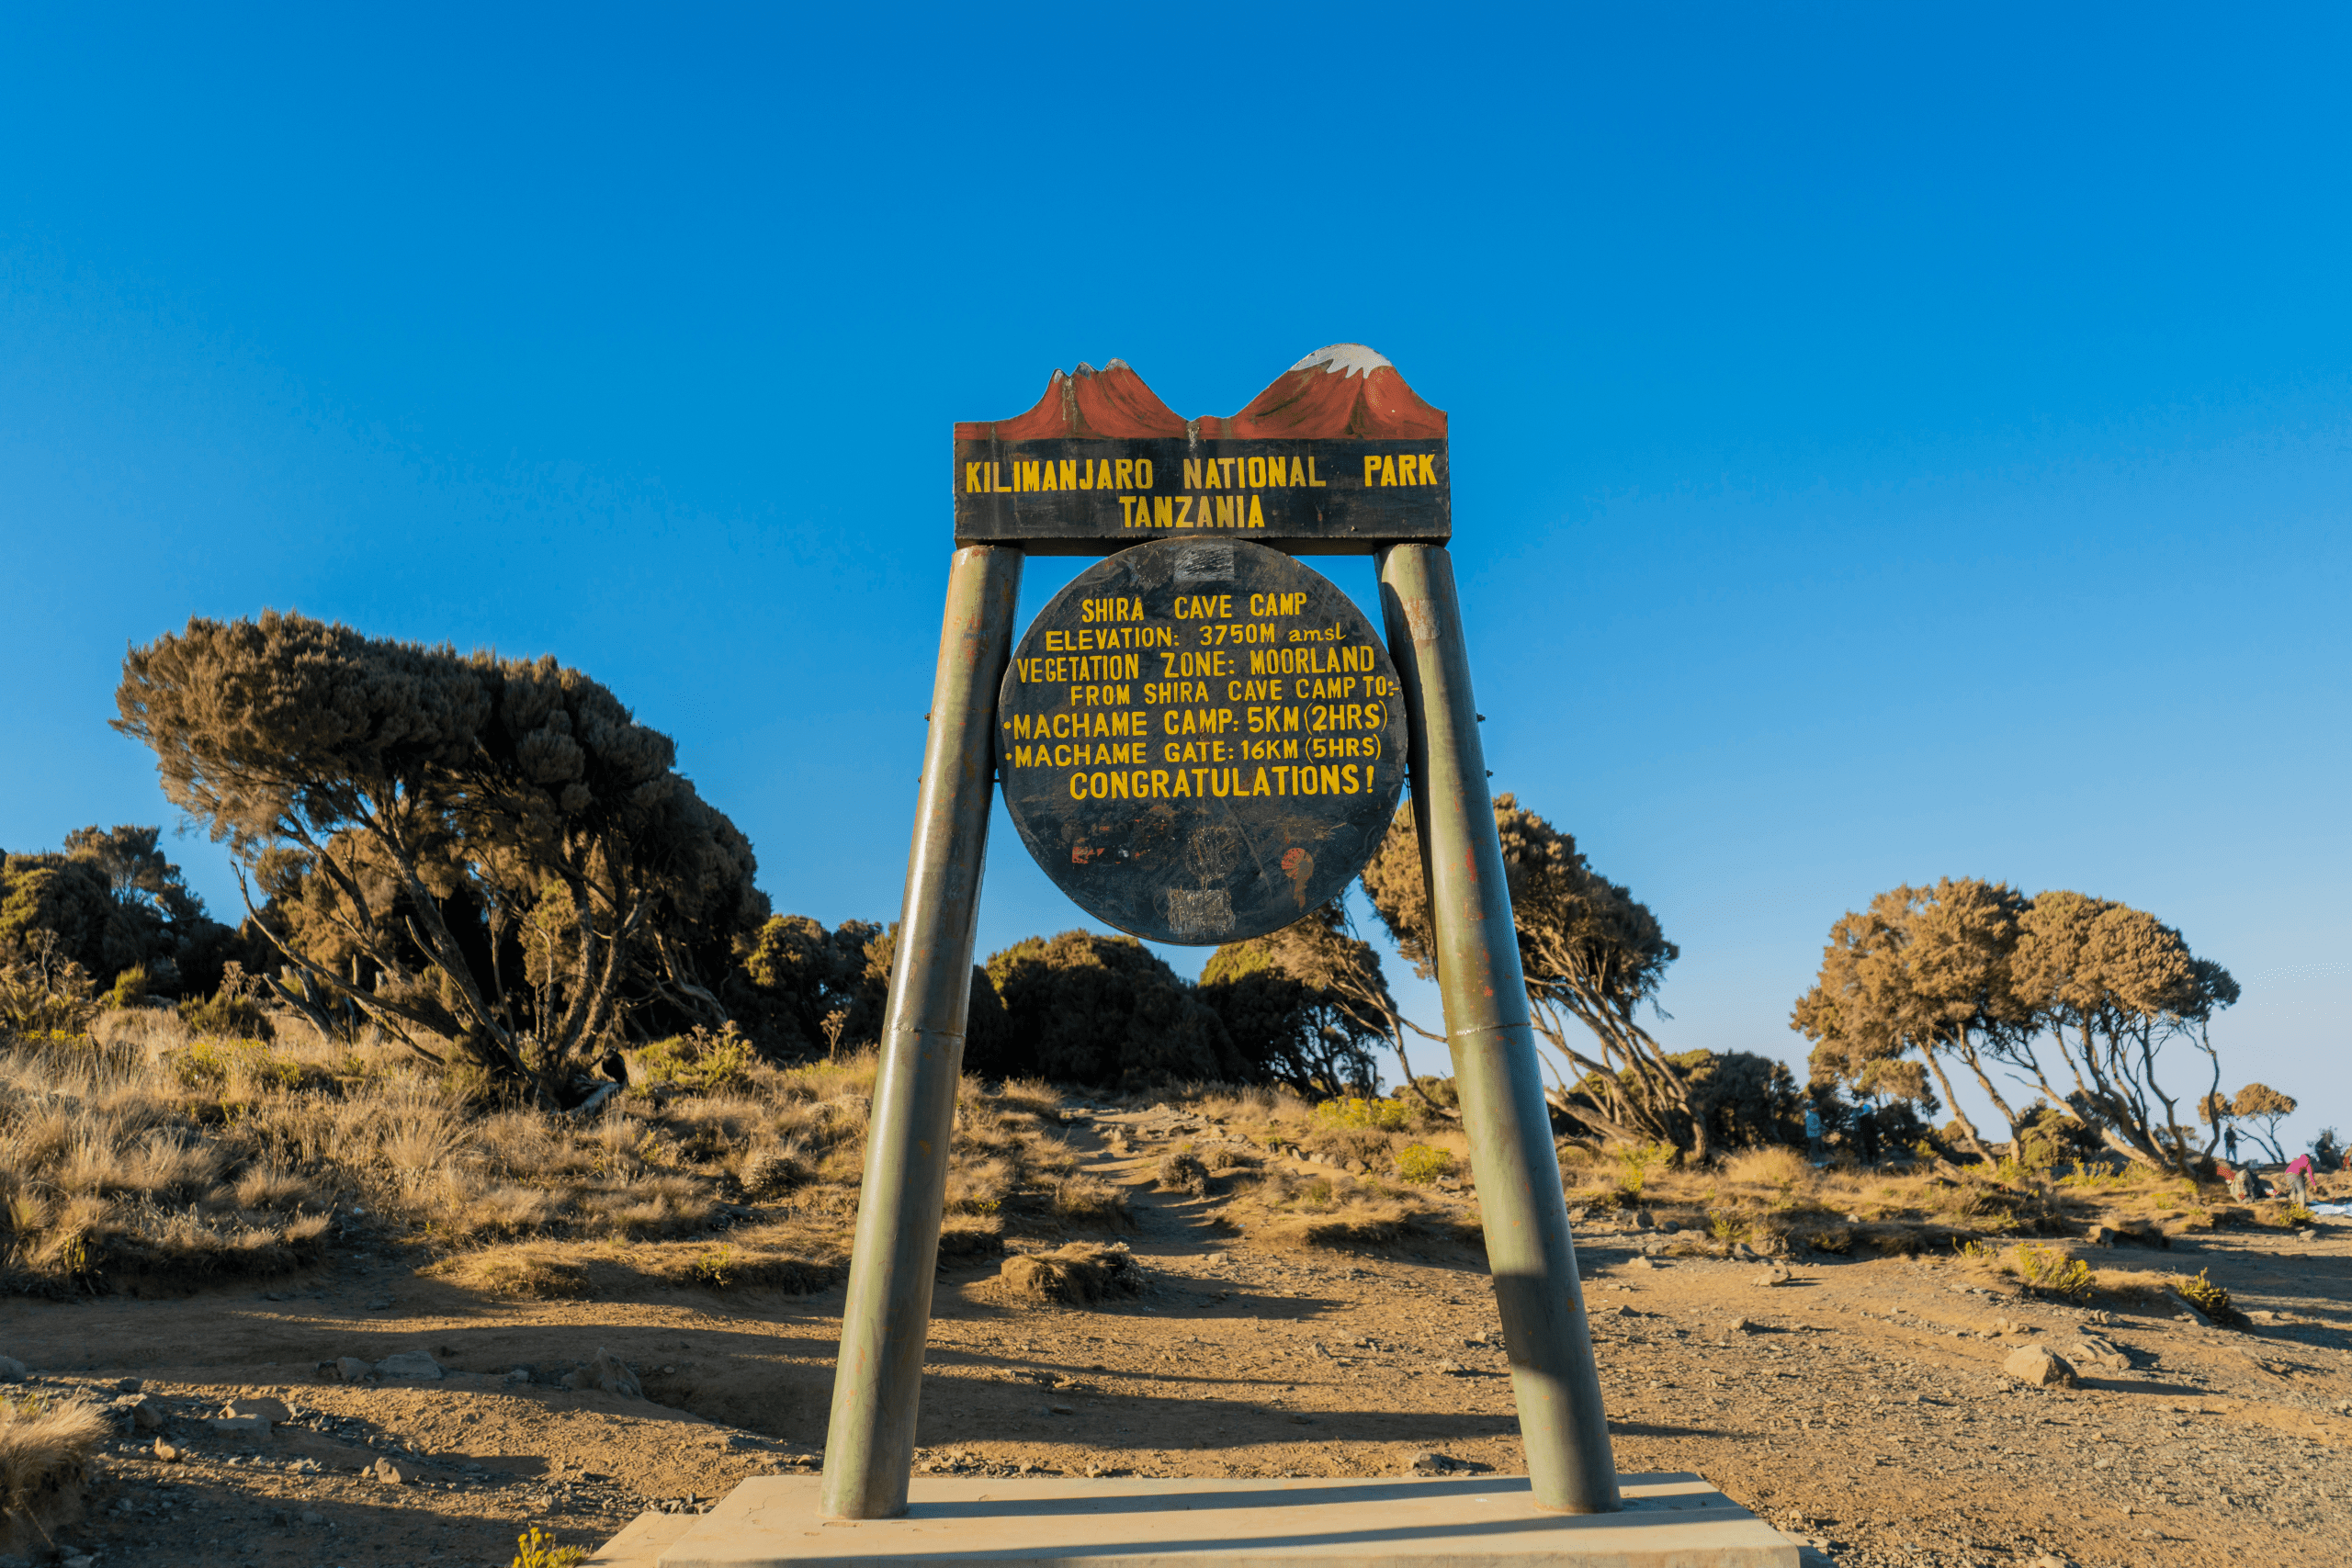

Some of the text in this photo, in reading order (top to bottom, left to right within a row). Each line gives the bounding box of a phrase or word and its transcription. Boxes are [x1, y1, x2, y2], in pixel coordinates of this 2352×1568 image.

[967, 454, 1437, 493] KILIMANJARO NATIONAL PARK
[1119, 495, 1264, 528] TANZANIA
[1082, 592, 1306, 623] SHIRA CAVE CAMP
[1046, 622, 1346, 651] ELEVATION: 3750M amsl
[1017, 646, 1374, 682] VEGETATION ZONE: MOORLAND
[1071, 684, 1130, 706] FROM
[1144, 681, 1209, 704] SHIRA
[1228, 680, 1282, 701] CAVE
[1295, 677, 1355, 699] CAMP
[1014, 712, 1147, 739] MACHAME
[1164, 708, 1238, 735] CAMP:
[1015, 742, 1147, 768] MACHAME
[1164, 739, 1234, 762] GATE:
[1070, 764, 1374, 800] CONGRATULATIONS!
